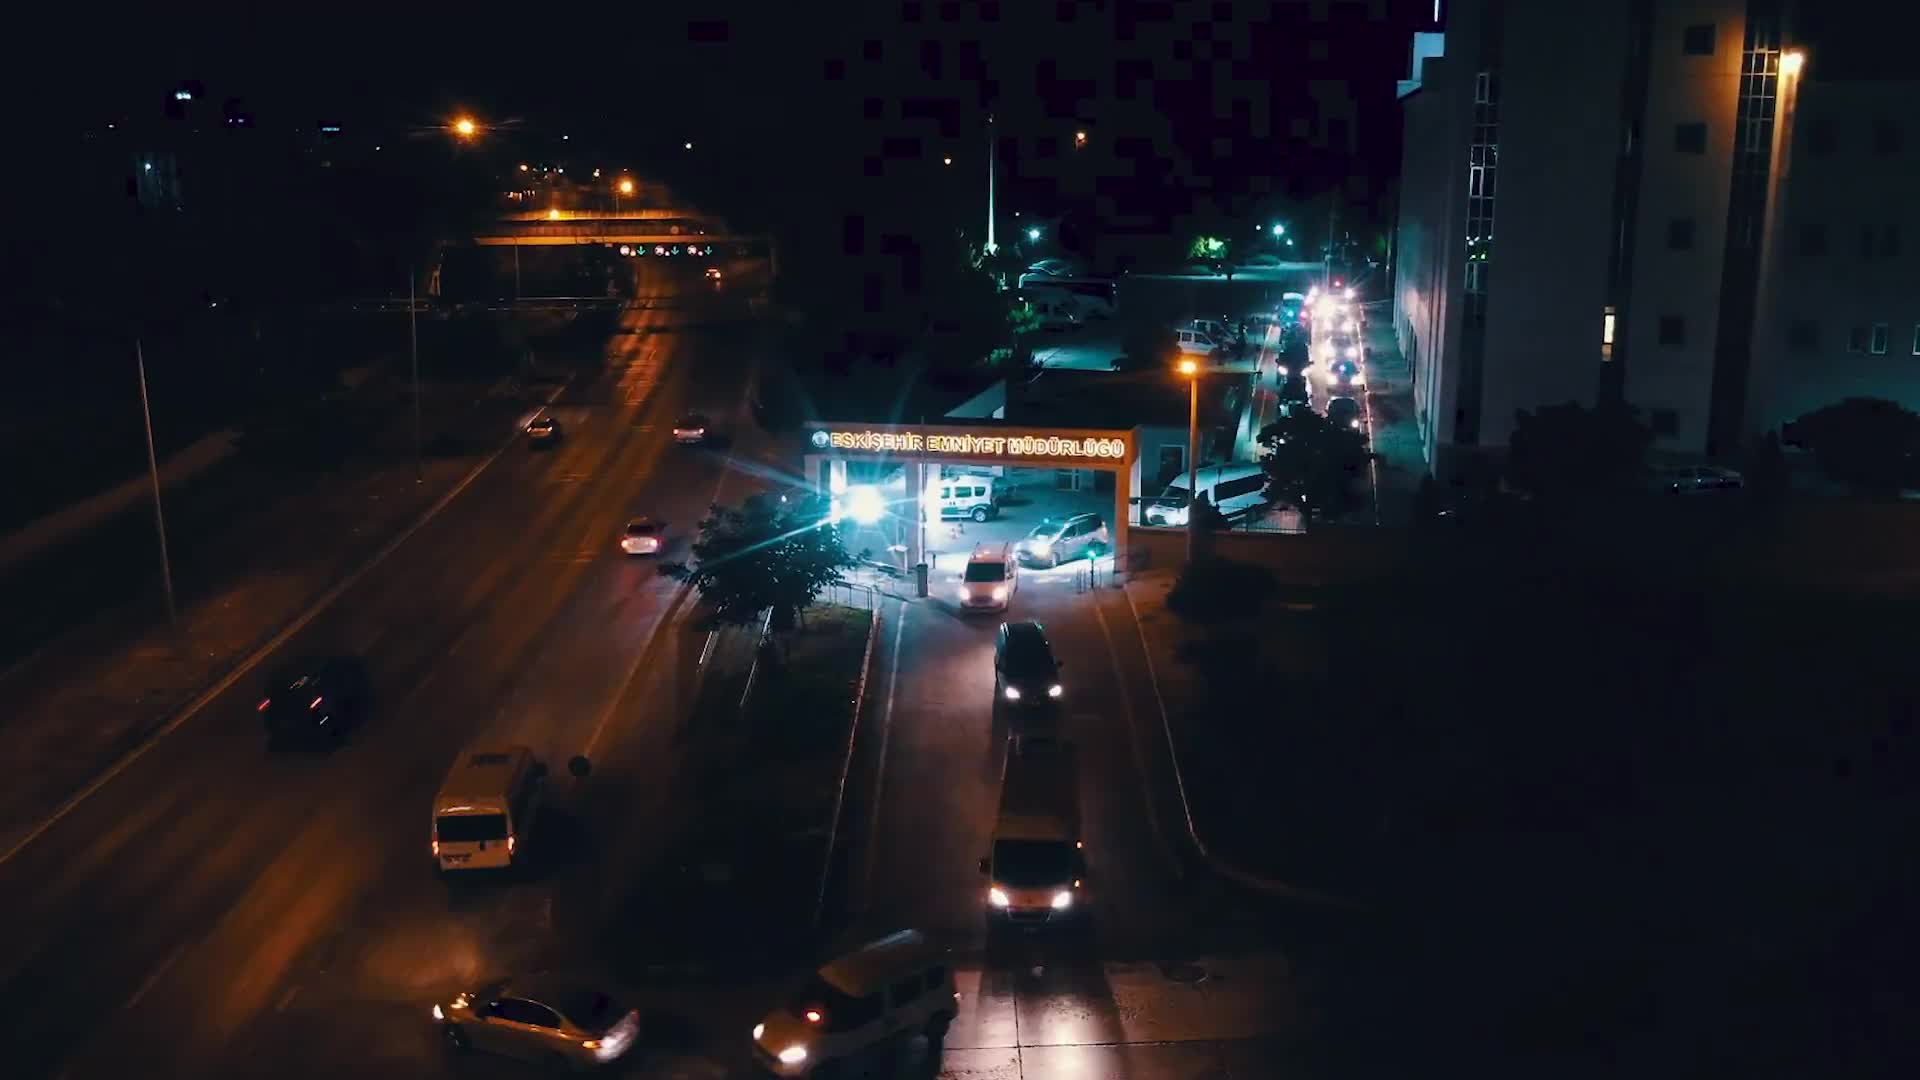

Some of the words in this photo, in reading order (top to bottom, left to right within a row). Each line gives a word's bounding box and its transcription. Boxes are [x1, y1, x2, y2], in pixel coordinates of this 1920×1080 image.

[830, 430, 924, 451] ESKİŞEHİR
[926, 434, 1005, 454] EMNİYET
[1007, 436, 1125, 457] MÜDÜRLÜĞÜ
